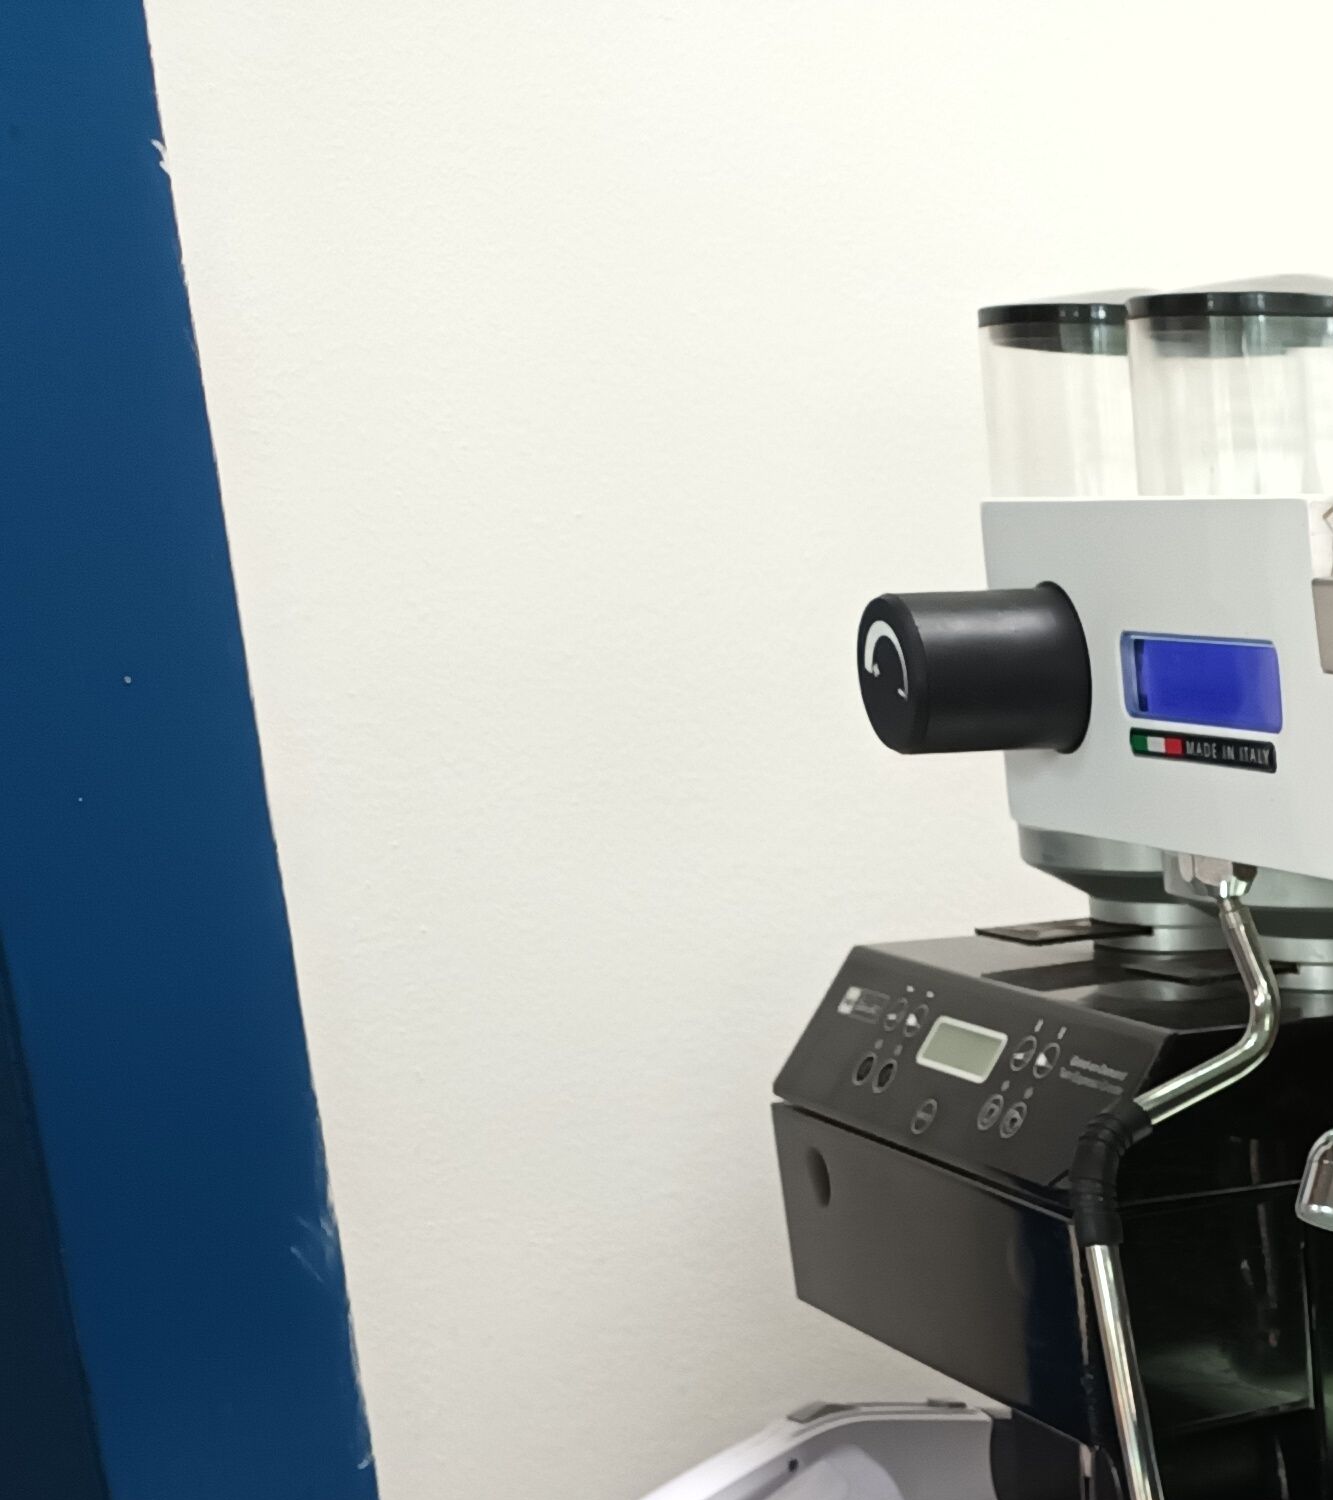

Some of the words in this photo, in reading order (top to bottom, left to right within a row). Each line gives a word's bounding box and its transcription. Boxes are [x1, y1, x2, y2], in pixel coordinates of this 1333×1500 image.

[1186, 740, 1217, 759] MADE
[1222, 745, 1235, 761] IN
[1239, 746, 1270, 766] ITALY
